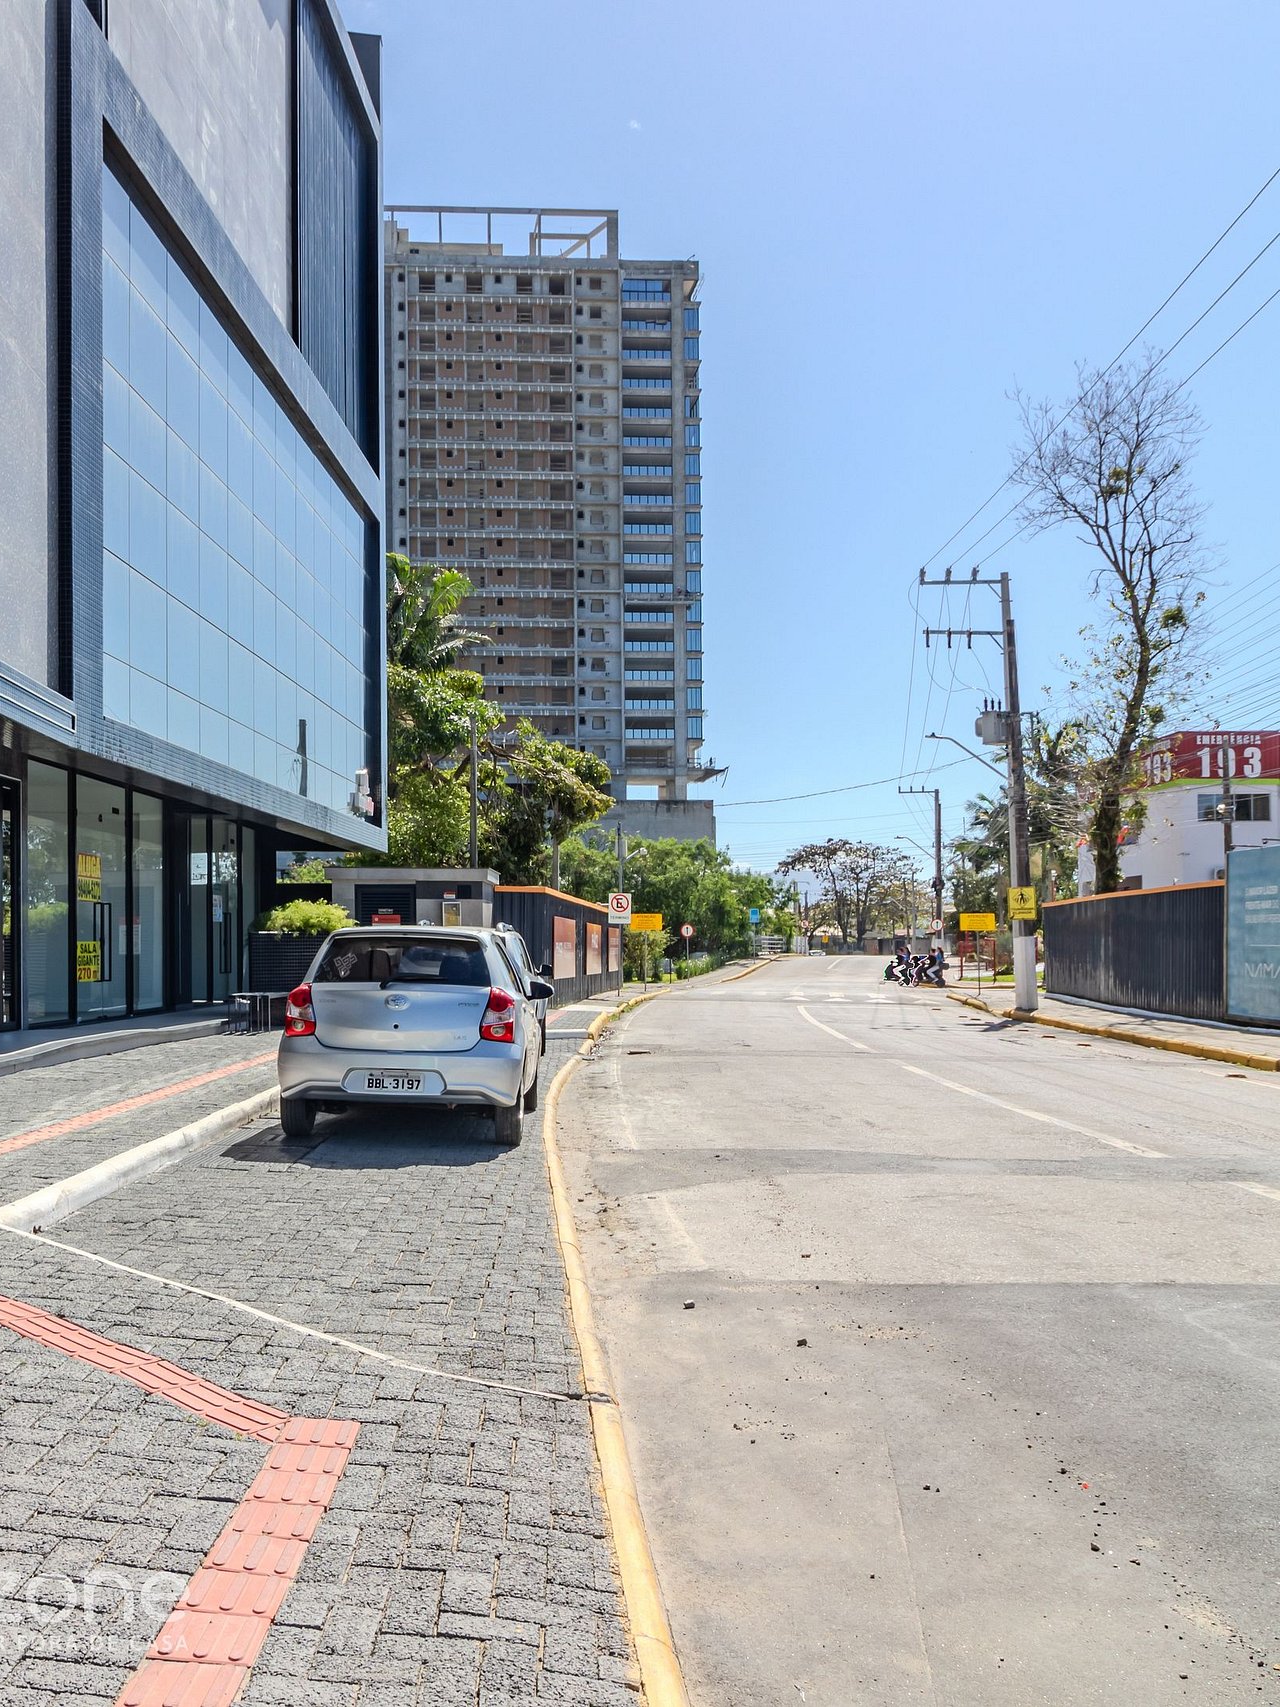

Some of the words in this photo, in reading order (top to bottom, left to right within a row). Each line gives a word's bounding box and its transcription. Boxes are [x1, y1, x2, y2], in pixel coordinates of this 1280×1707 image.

[1197, 747, 1262, 778] 193
[78, 854, 101, 878] ALUGA
[80, 943, 97, 954] SALA
[77, 955, 100, 967] GIGANTE
[78, 968, 91, 980] 270
